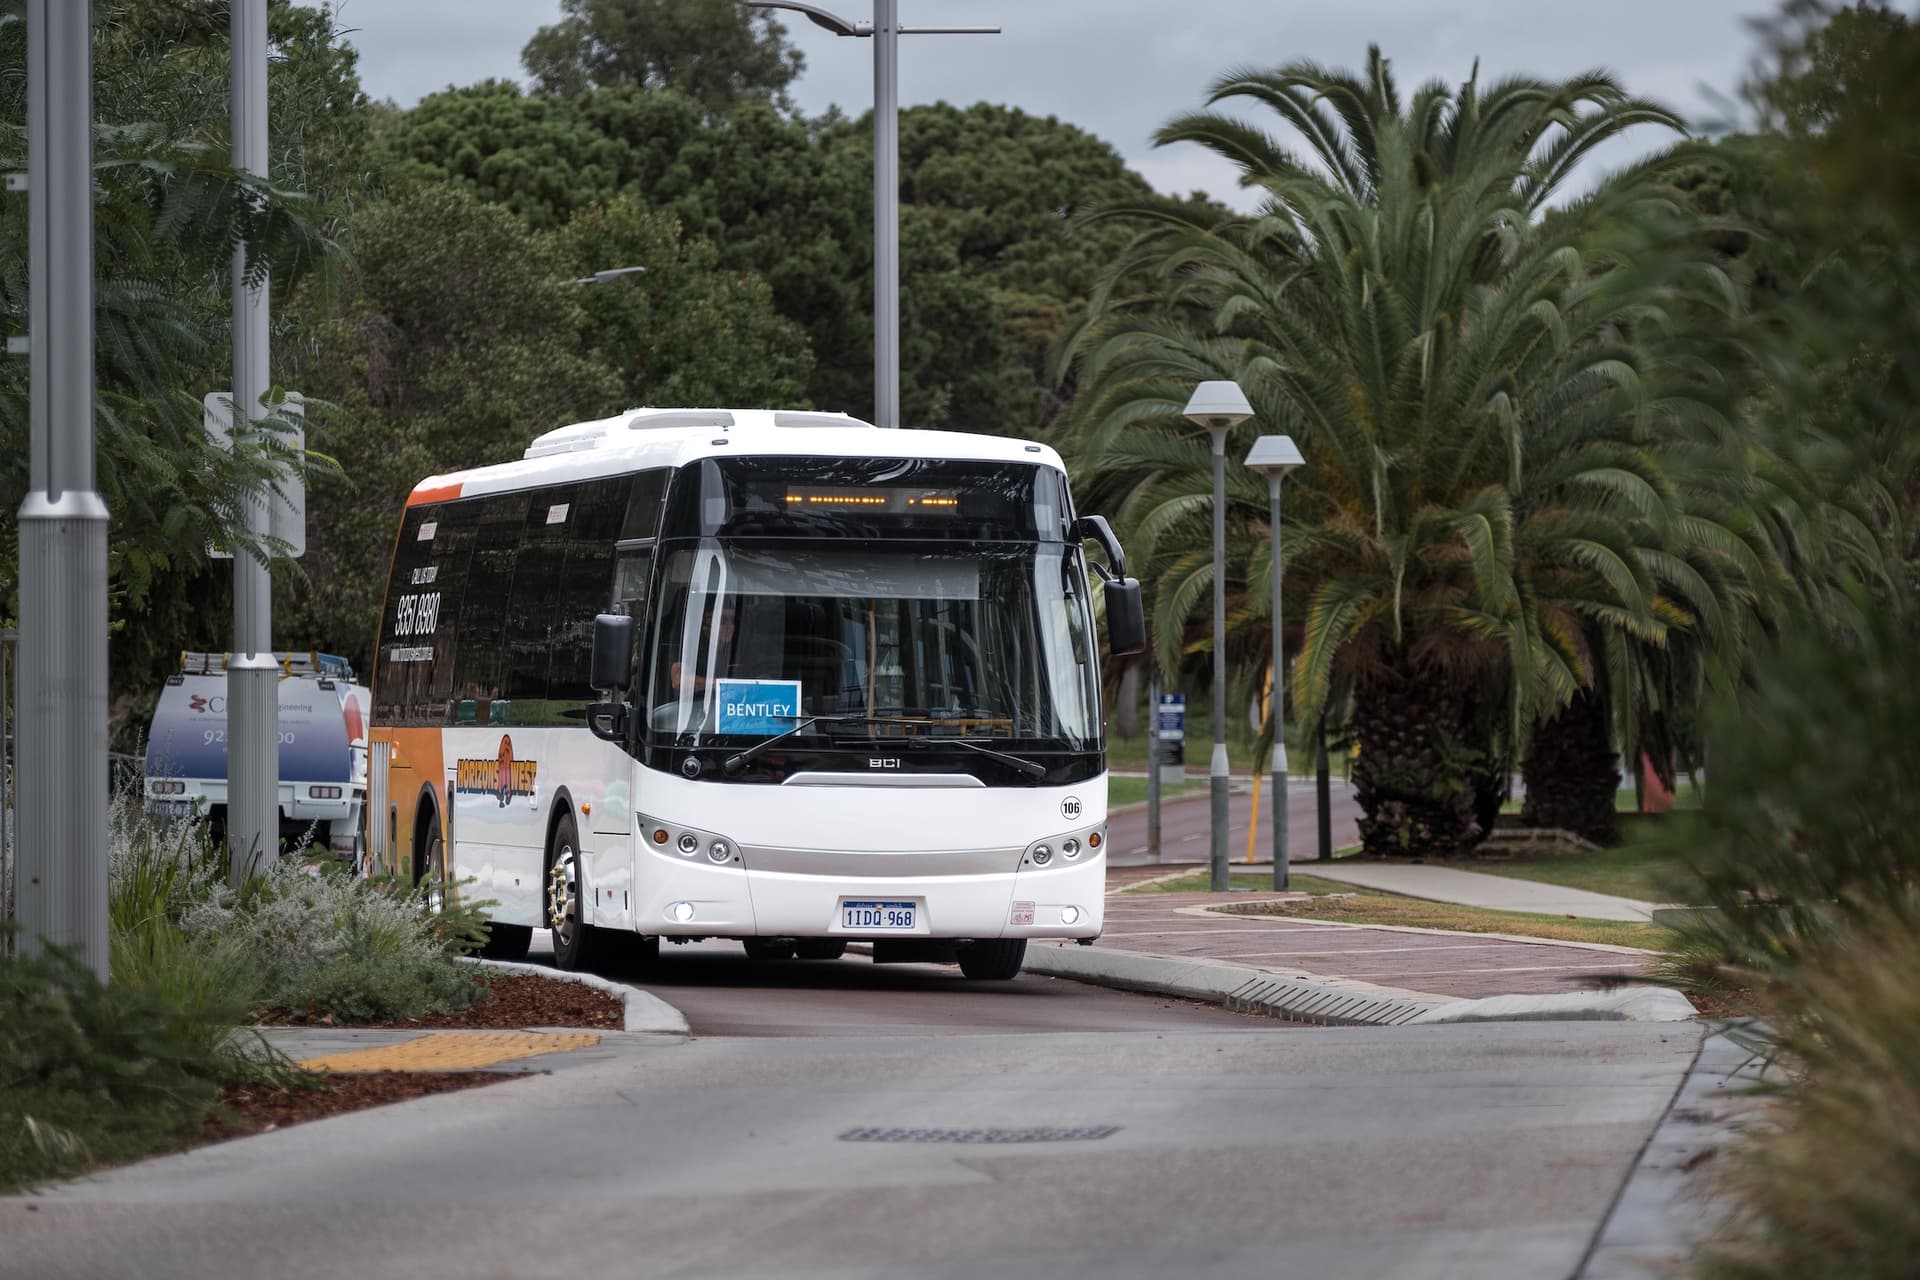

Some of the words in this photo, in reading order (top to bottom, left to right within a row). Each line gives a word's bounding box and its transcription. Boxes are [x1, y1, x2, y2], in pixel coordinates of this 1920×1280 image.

[395, 594, 418, 636] 9357
[415, 592, 441, 635] 8980
[727, 703, 791, 717] BENTLEY
[869, 758, 900, 768] BCI
[457, 759, 500, 790] HORIZONS
[510, 760, 537, 793] WEST
[1063, 802, 1080, 814] 106
